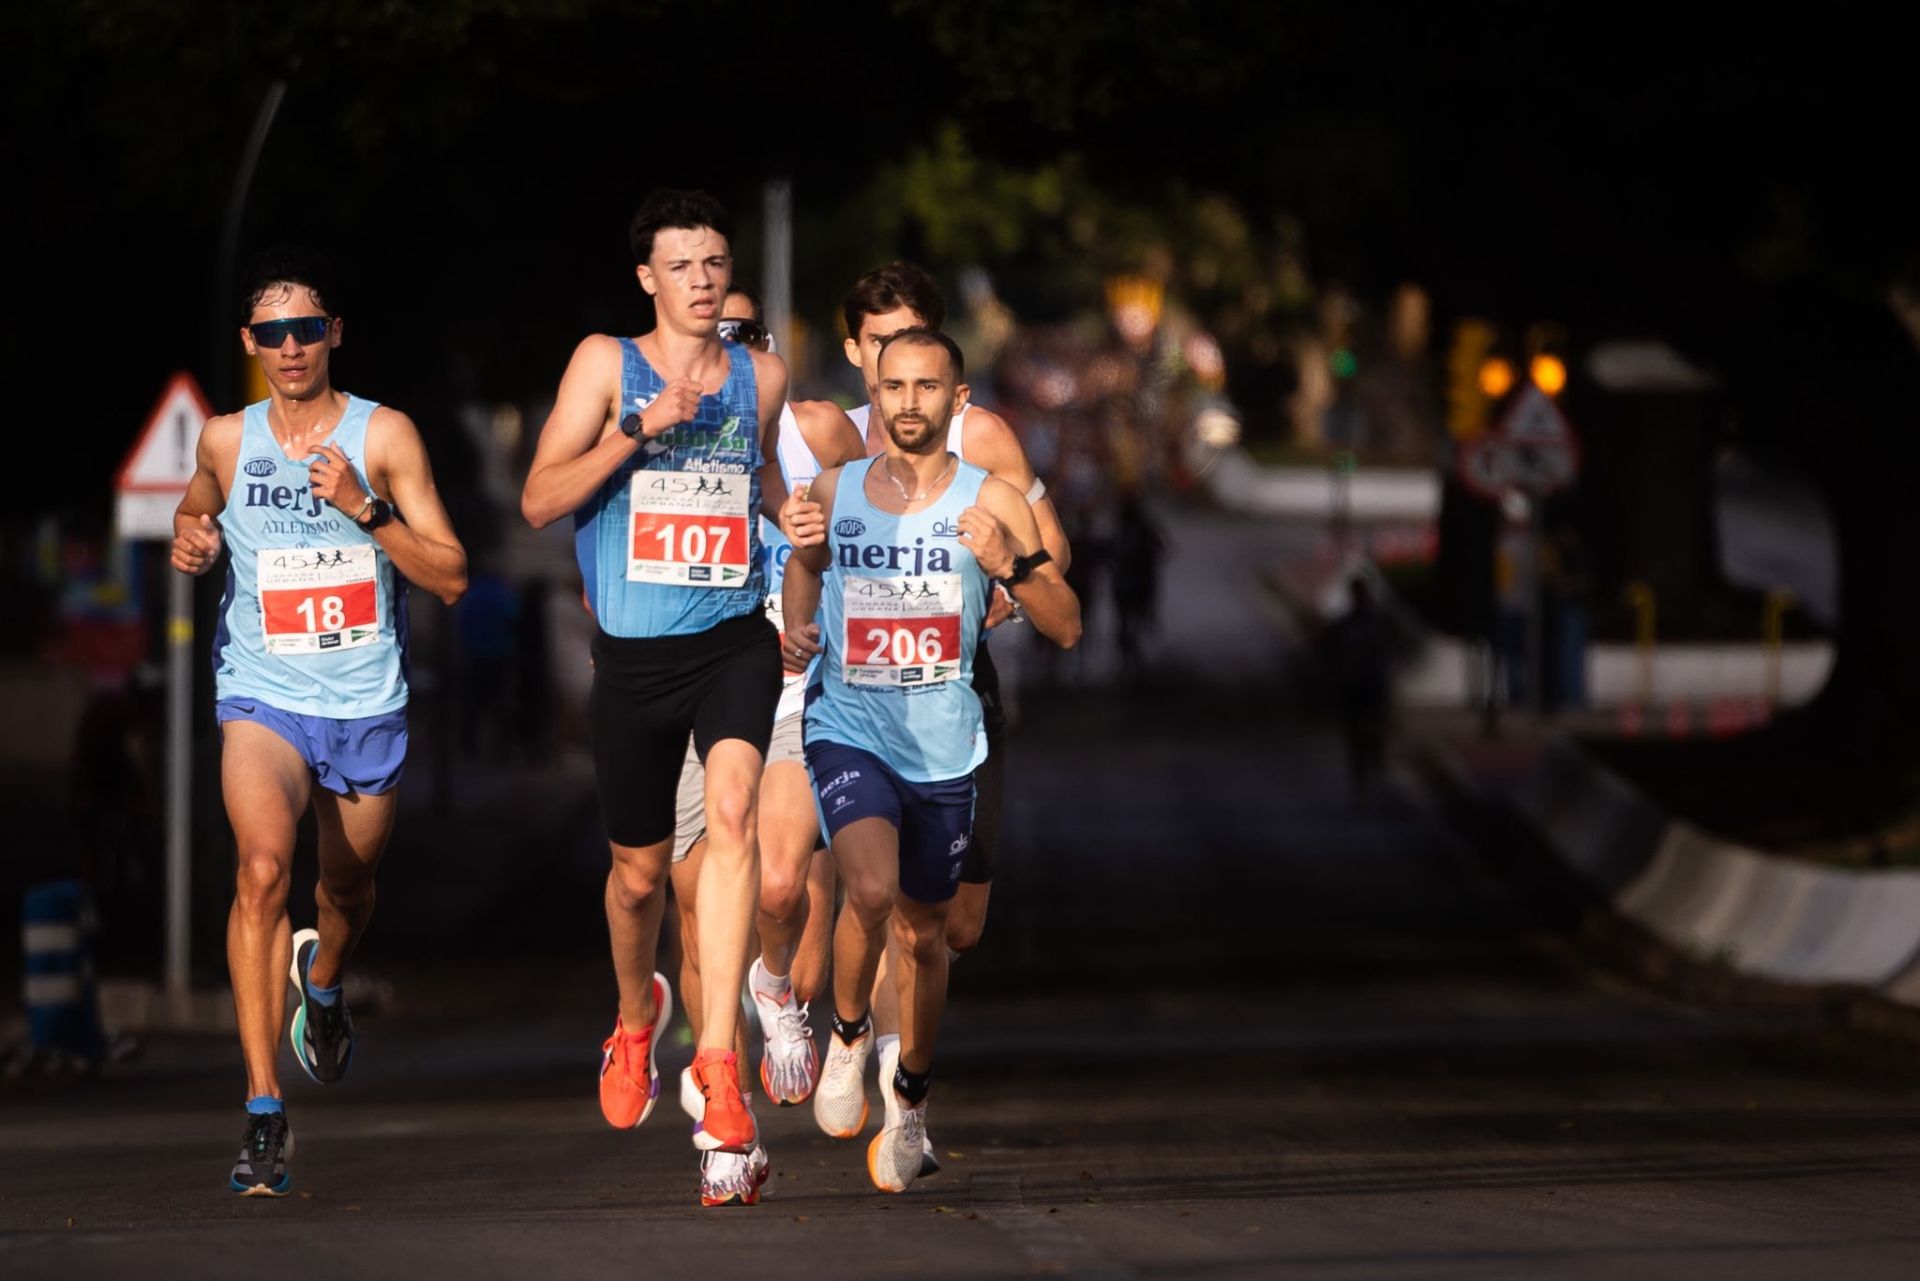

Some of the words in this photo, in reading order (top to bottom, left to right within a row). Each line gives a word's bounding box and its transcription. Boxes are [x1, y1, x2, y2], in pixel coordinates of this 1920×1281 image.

[245, 460, 276, 475] TROPS
[683, 457, 745, 474] Atletismo
[651, 478, 688, 493] 45
[246, 483, 334, 517] nerj
[262, 519, 340, 535] ATLETISMO
[836, 520, 865, 536] TROPS
[656, 523, 731, 563] 107
[274, 555, 308, 569] 45
[838, 537, 952, 577] nerja
[859, 583, 894, 597] 45
[296, 595, 346, 633] 18
[866, 627, 943, 665] 206
